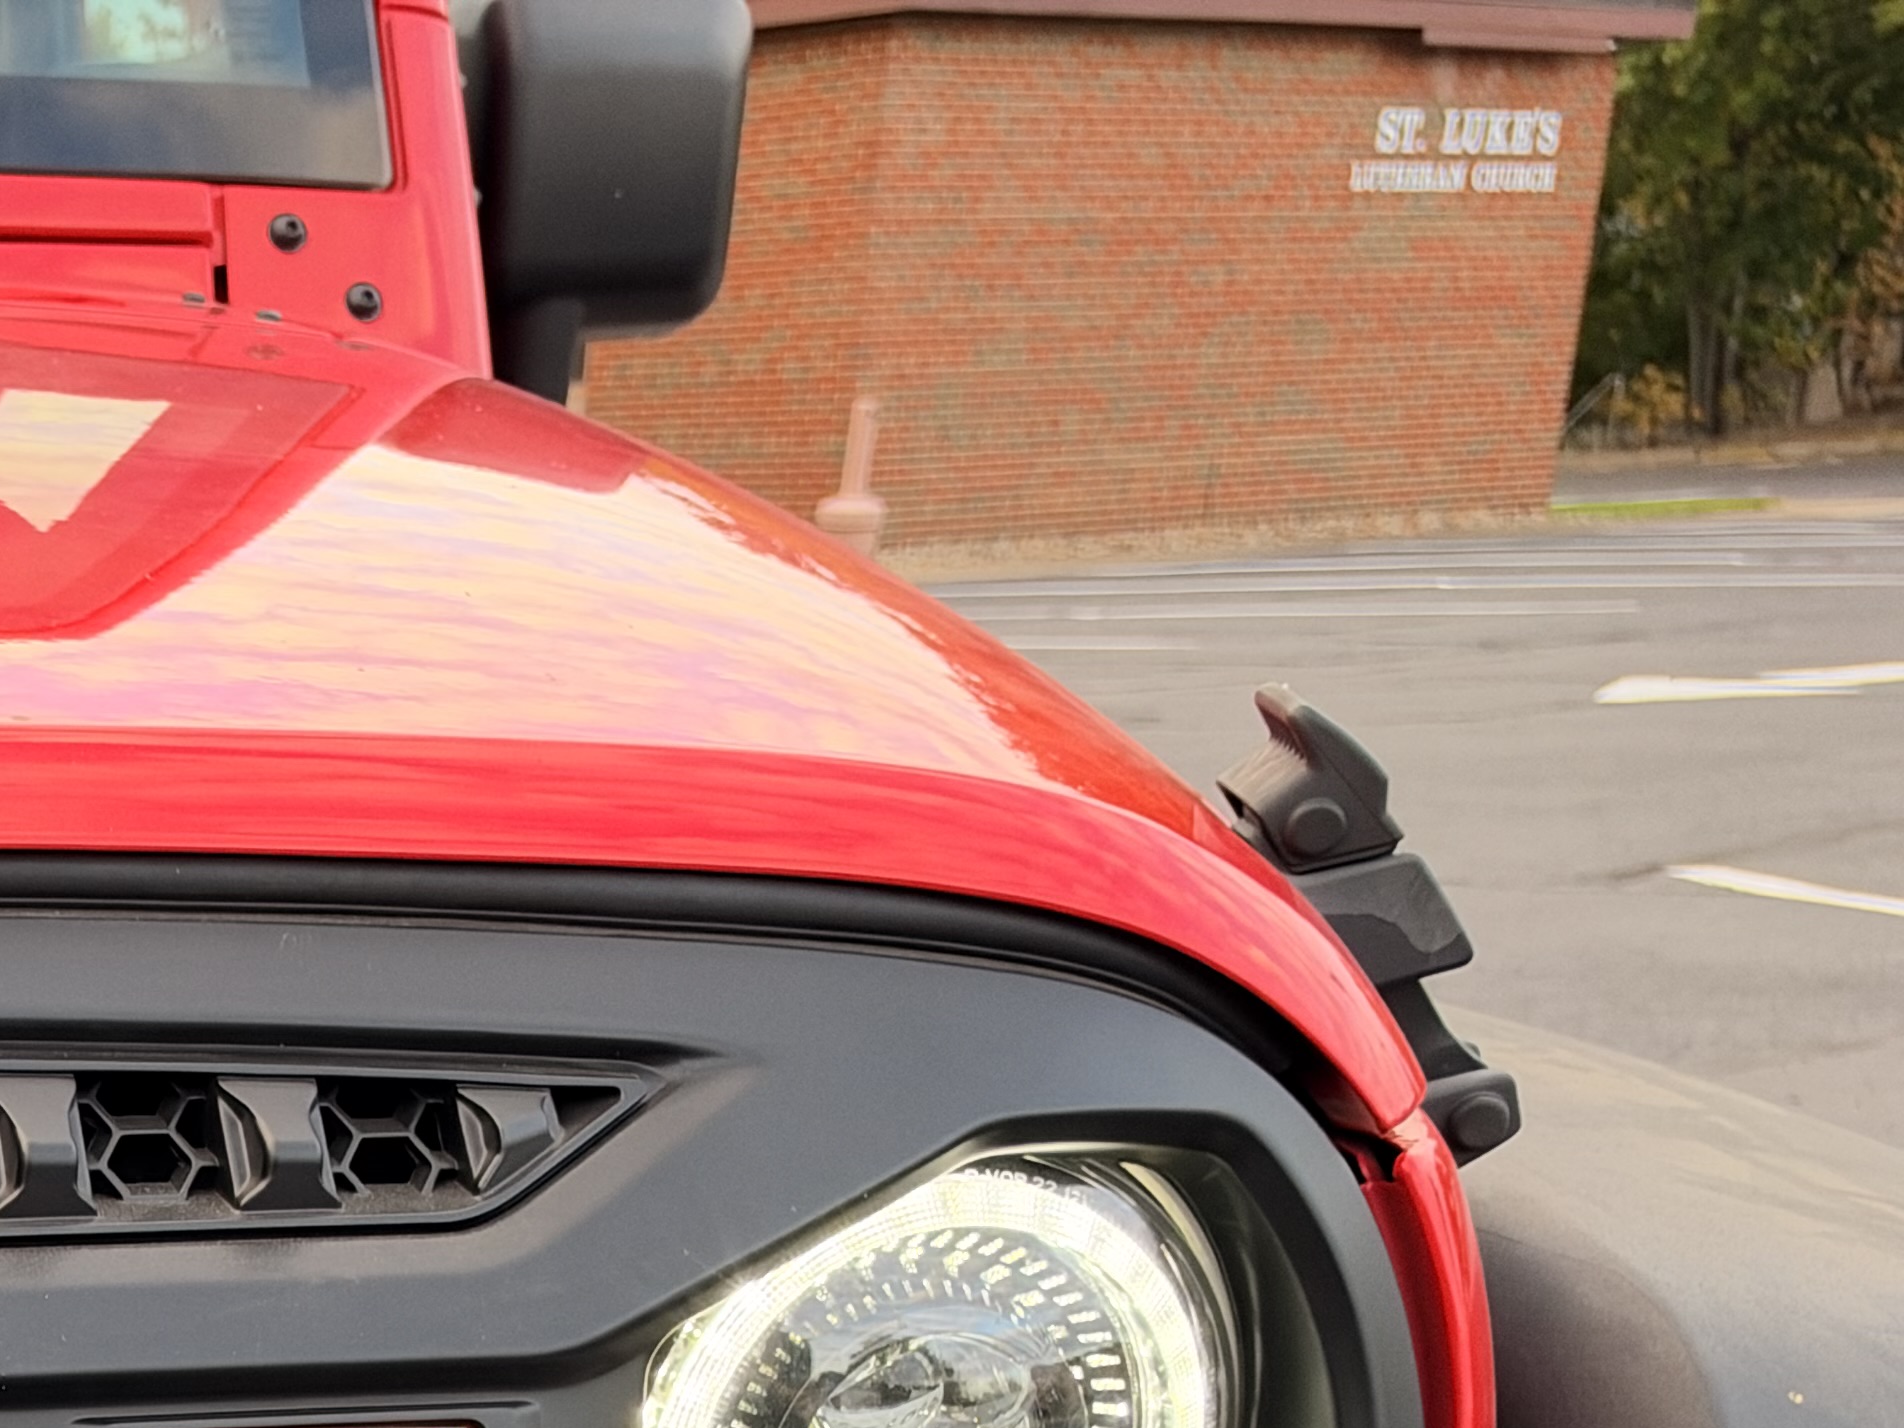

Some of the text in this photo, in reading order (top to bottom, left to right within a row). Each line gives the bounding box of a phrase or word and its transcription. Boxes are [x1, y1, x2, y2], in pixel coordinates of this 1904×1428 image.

[1375, 106, 1562, 156] ST. LUKE'S
[1471, 160, 1557, 193] CHURCH
